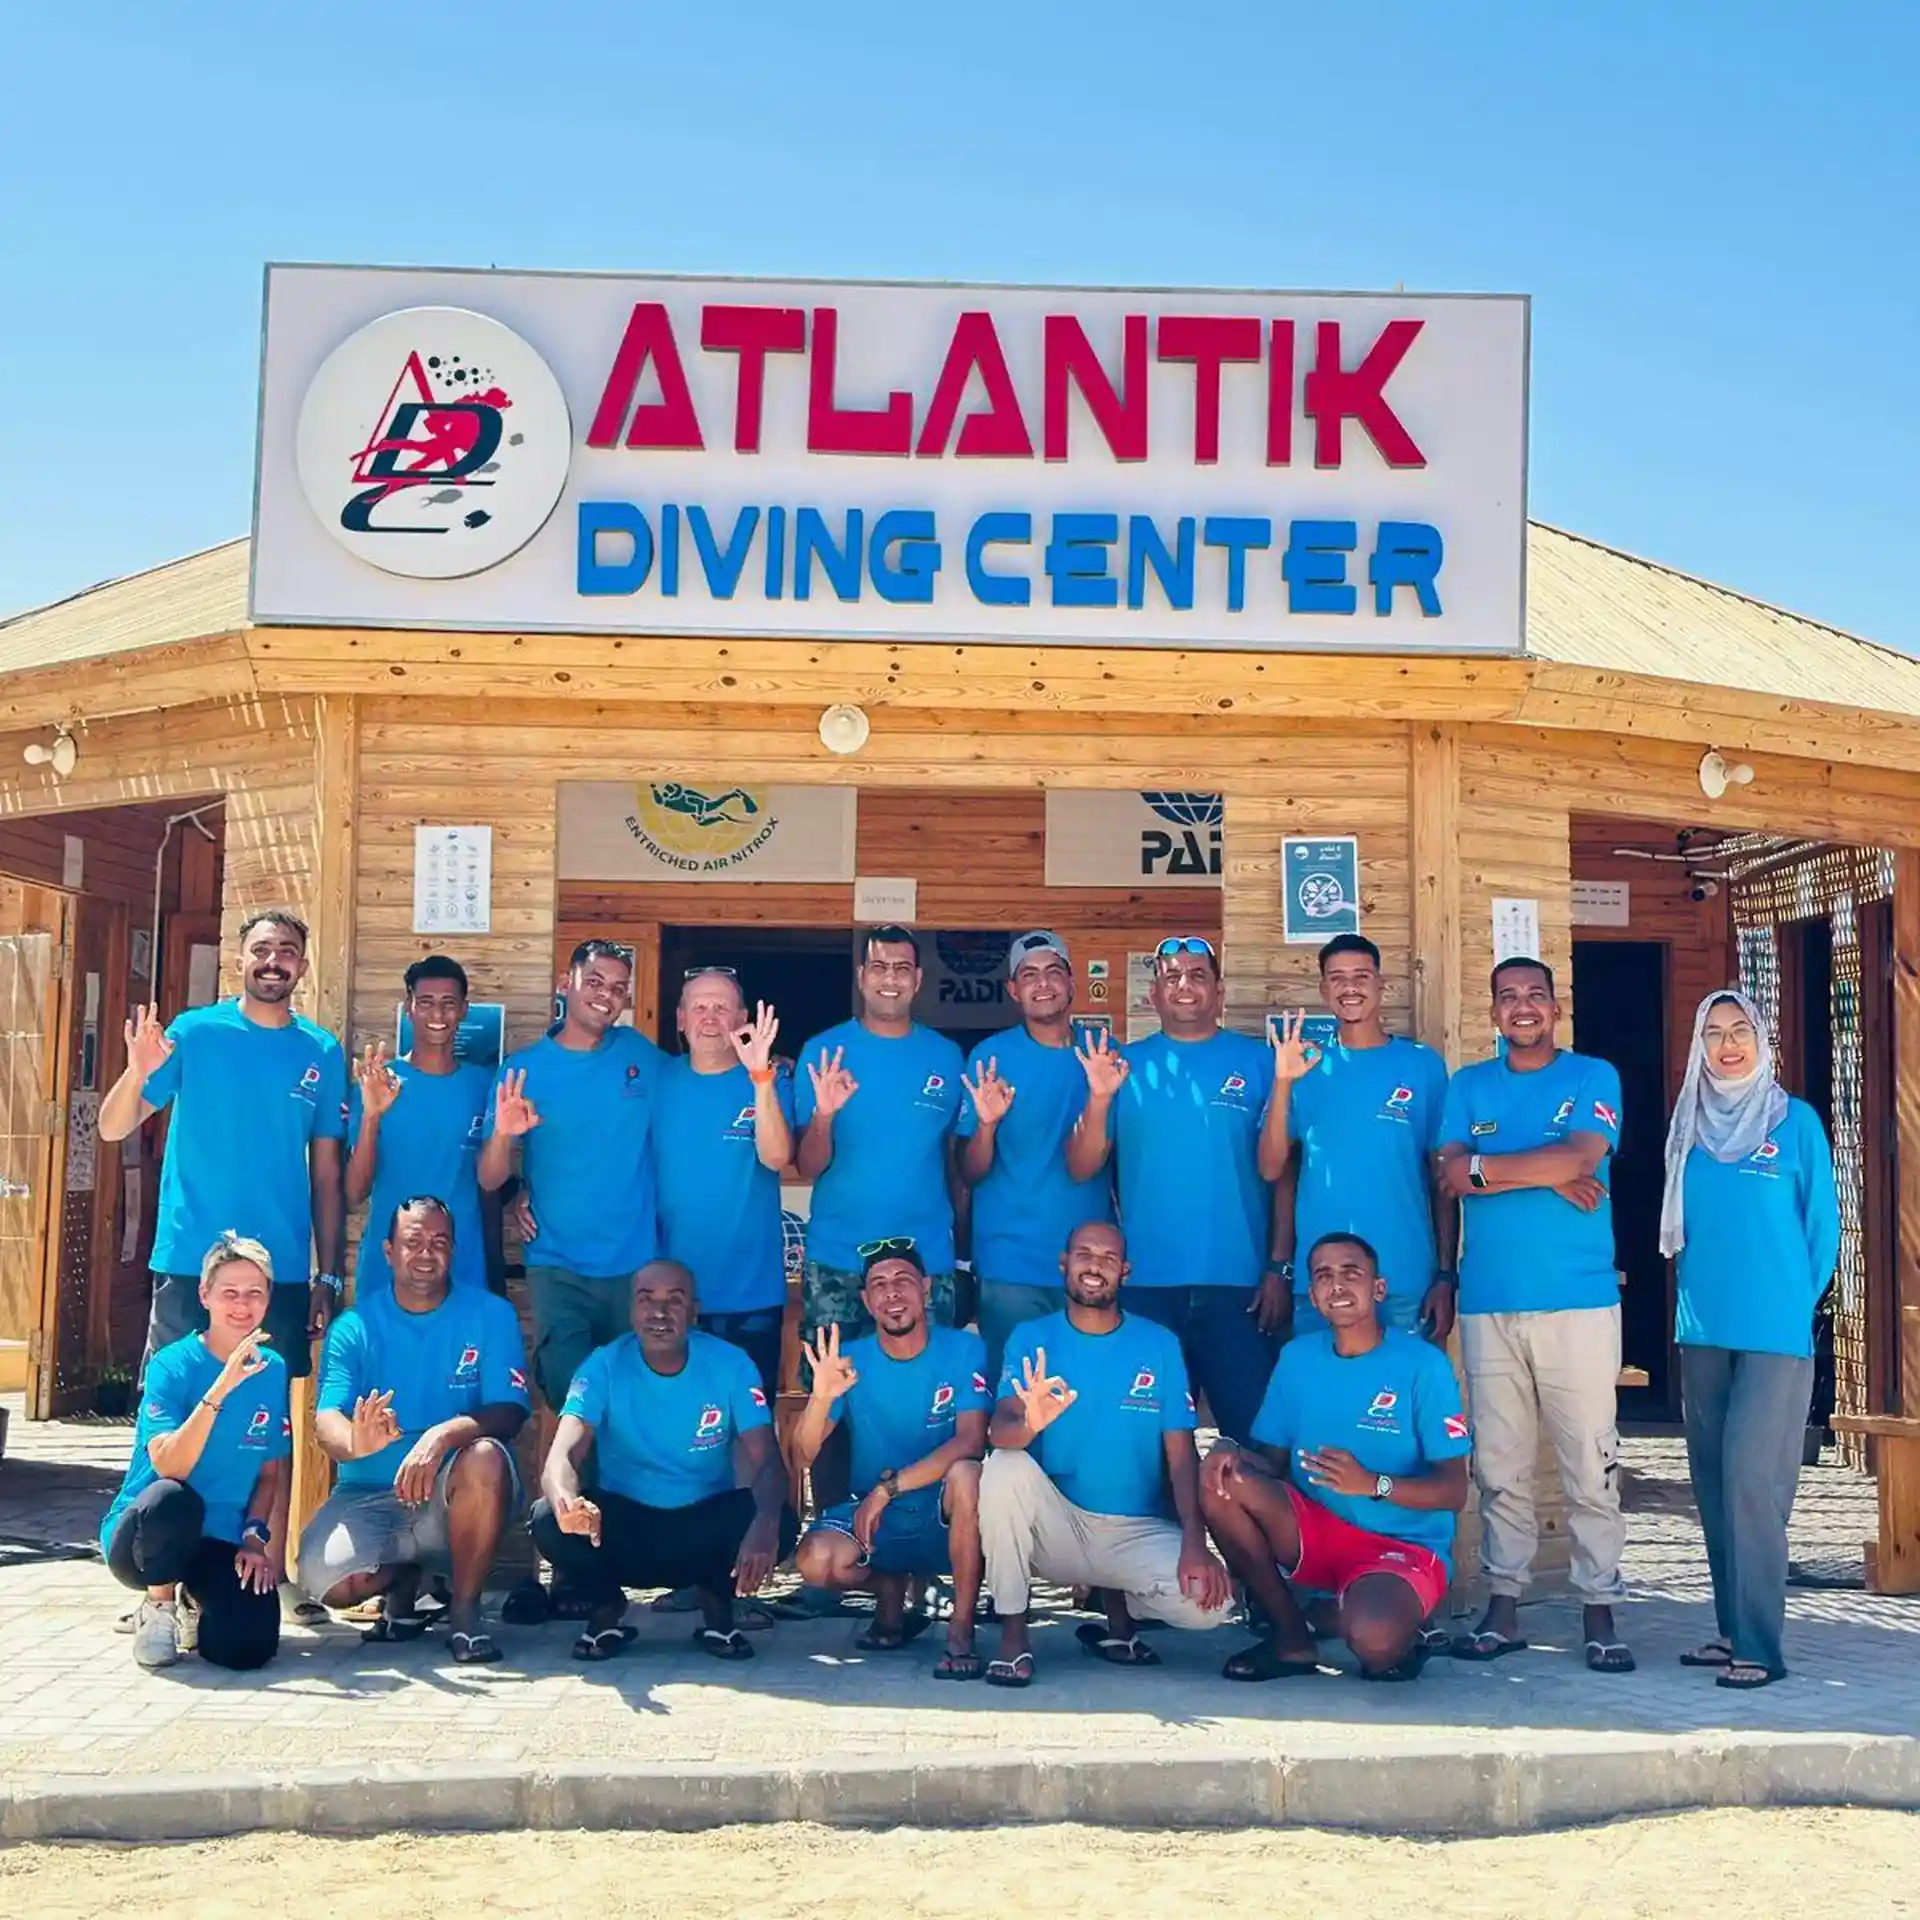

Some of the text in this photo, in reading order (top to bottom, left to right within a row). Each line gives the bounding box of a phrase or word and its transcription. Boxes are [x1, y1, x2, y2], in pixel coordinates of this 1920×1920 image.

[588, 302, 1426, 468] ATLANTIK
[577, 500, 1444, 616] DIVING CENTER
[625, 815, 780, 872] ENTRICHED AIR NITROX
[938, 979, 1003, 1004] PADI
